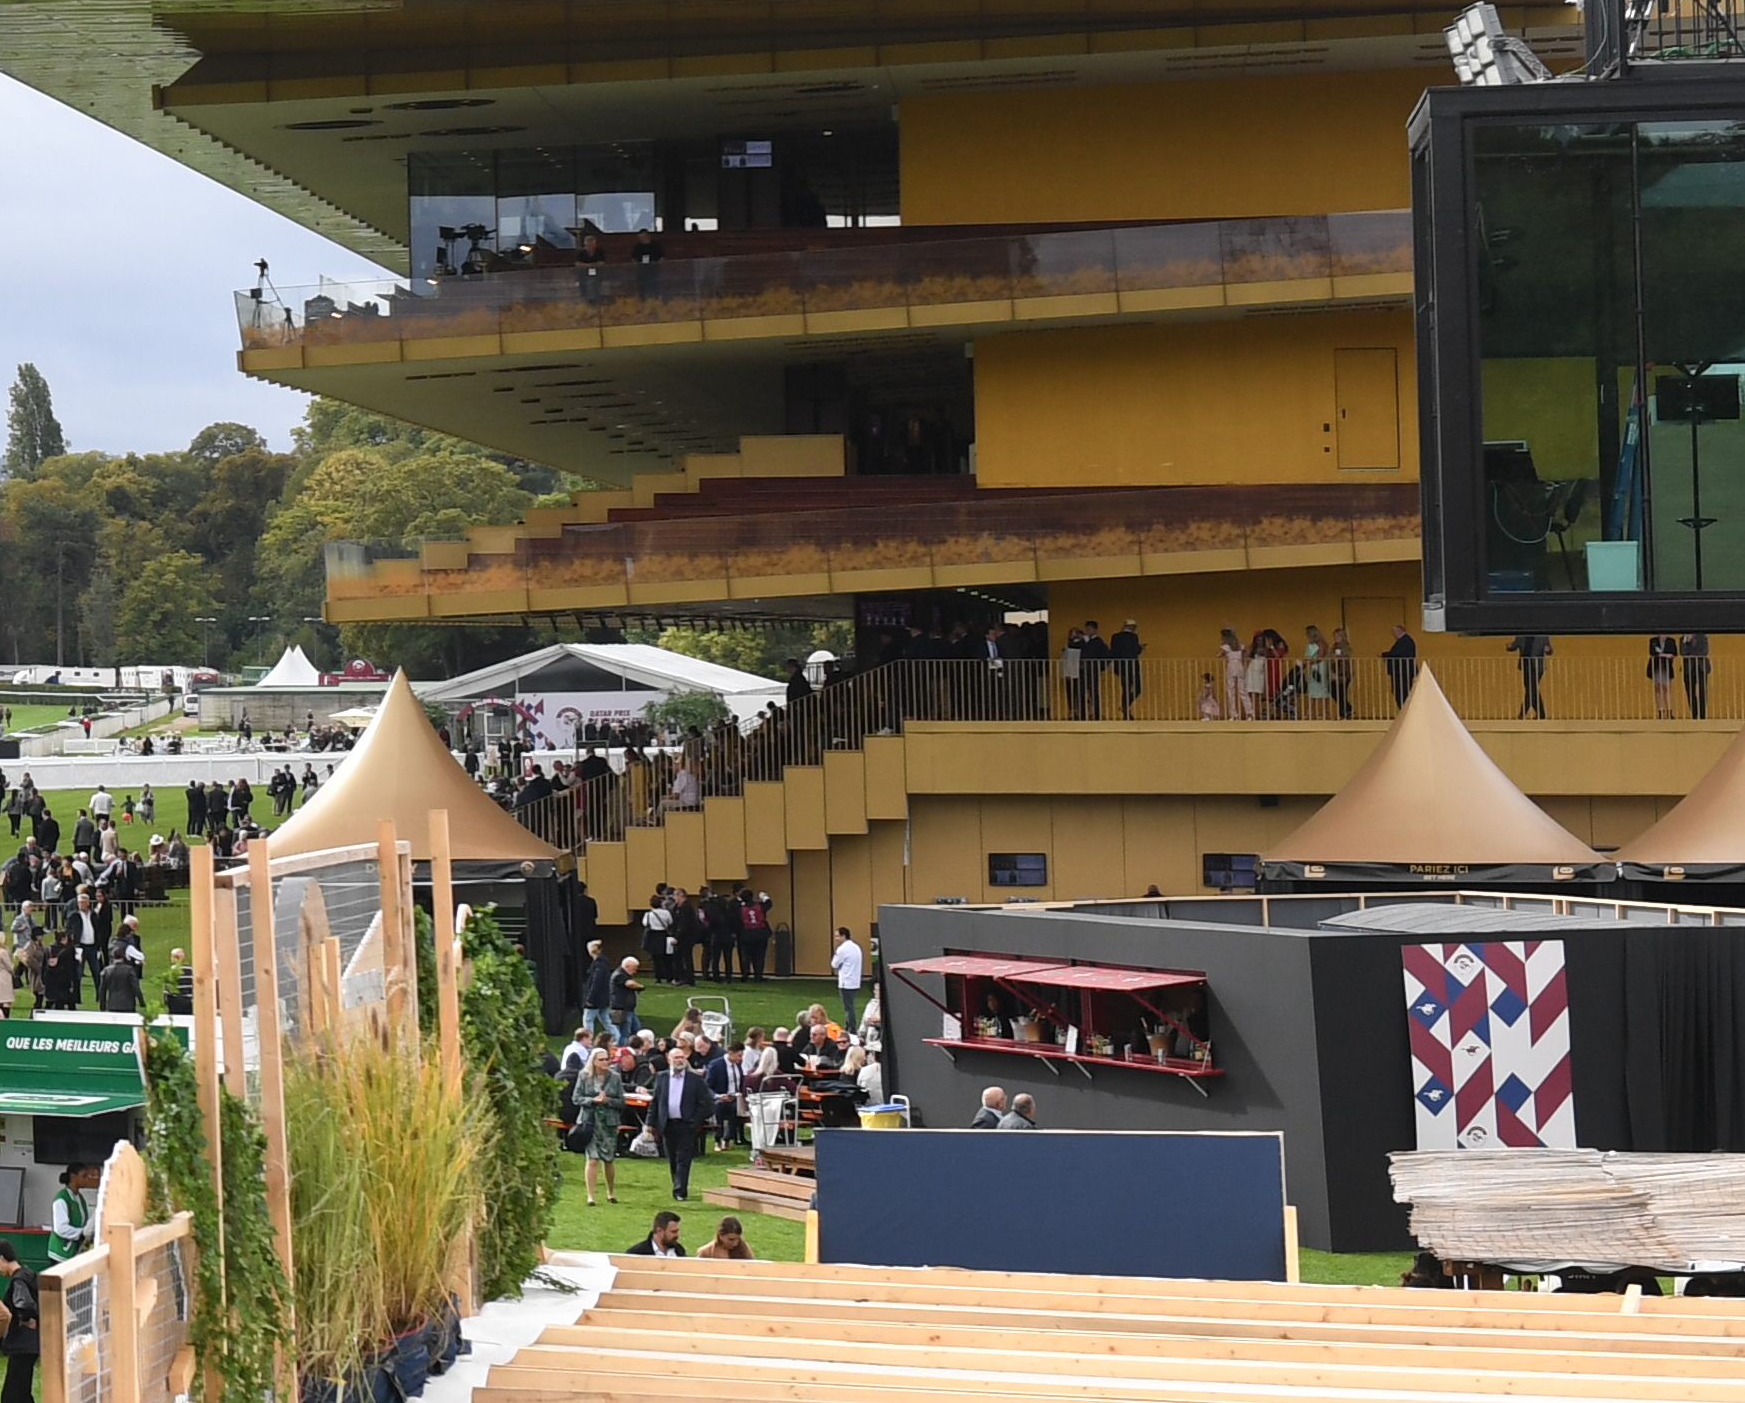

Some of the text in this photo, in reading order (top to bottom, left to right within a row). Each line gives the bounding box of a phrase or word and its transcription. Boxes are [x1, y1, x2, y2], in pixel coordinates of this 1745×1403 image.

[1410, 864, 1469, 874] PARIEZ ICI
[6, 1036, 30, 1049] QUE
[32, 1038, 53, 1050] LES
[55, 1038, 119, 1053] MEILLEURS
